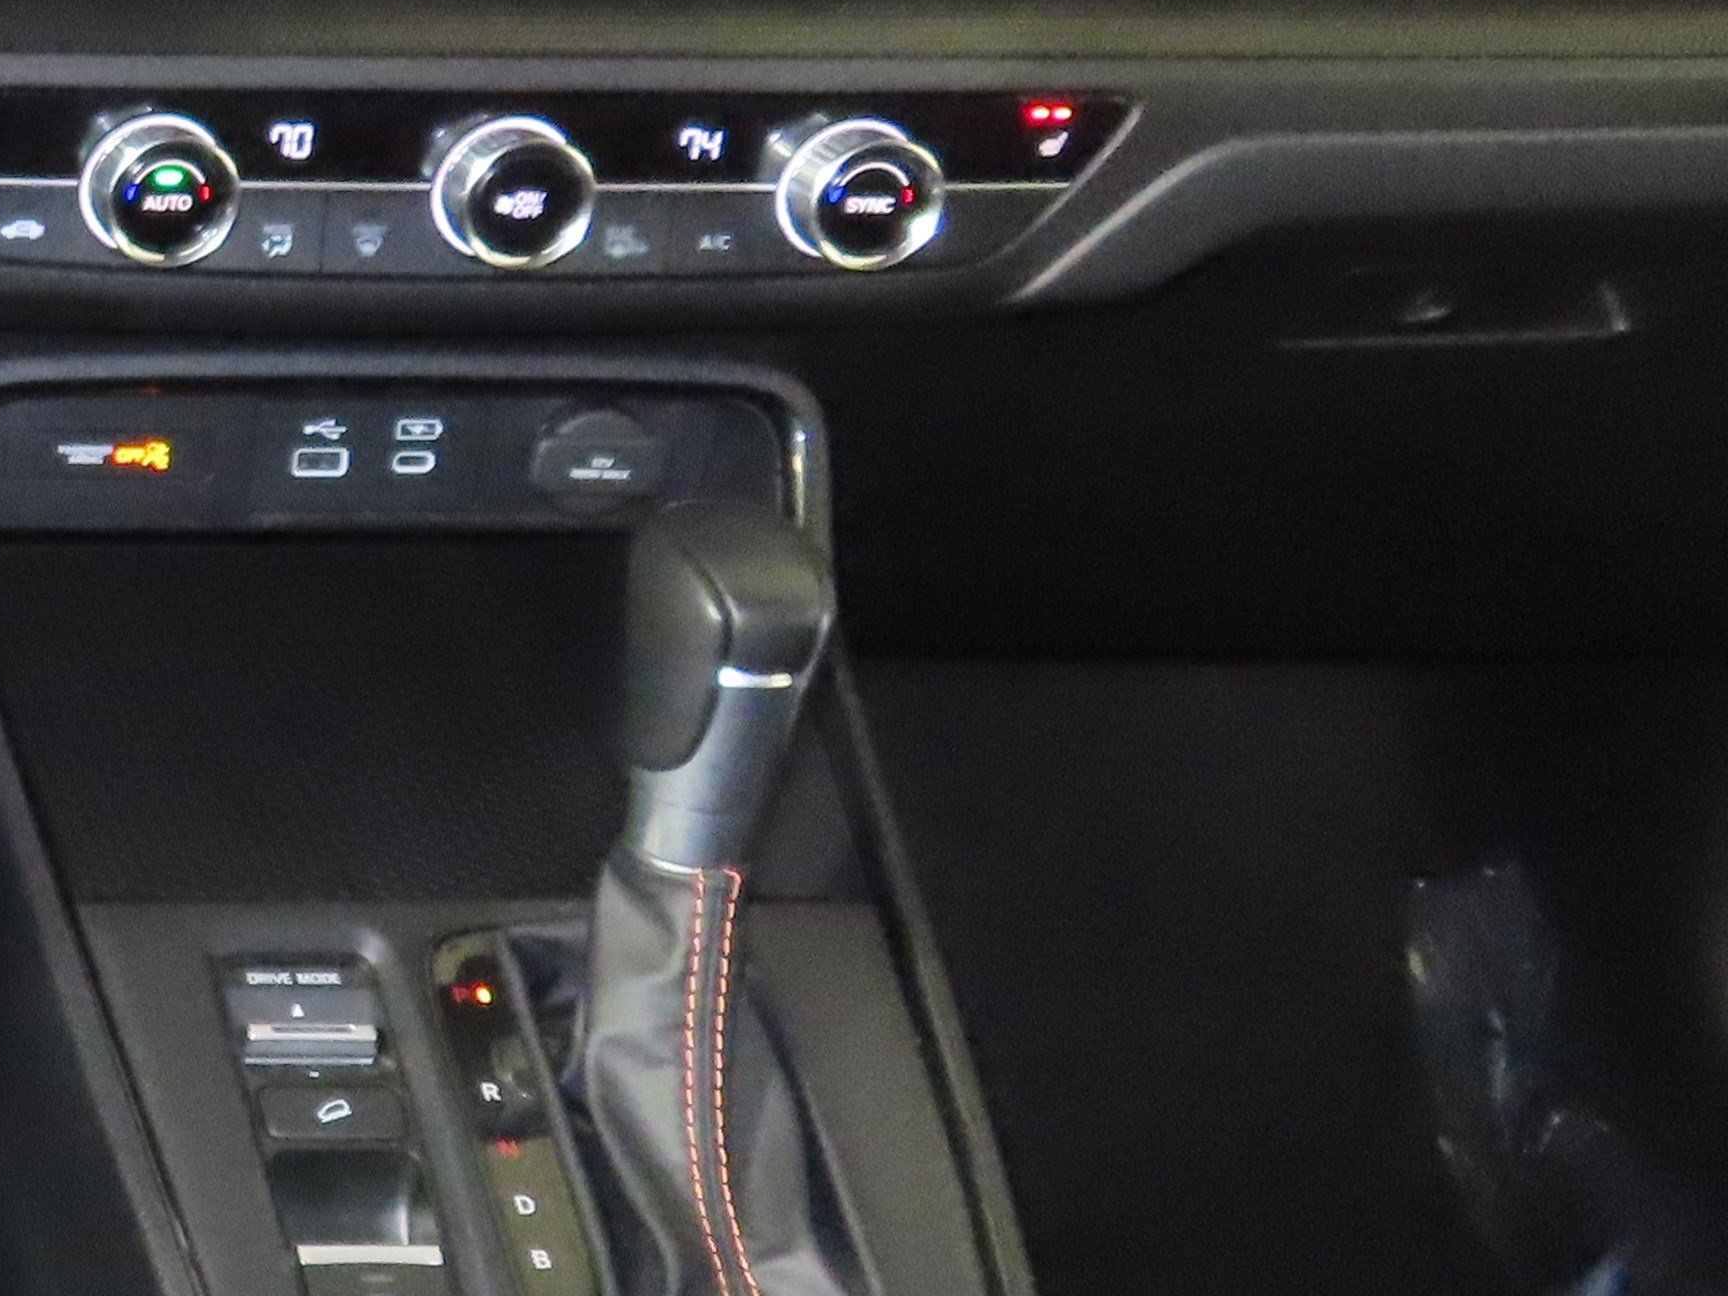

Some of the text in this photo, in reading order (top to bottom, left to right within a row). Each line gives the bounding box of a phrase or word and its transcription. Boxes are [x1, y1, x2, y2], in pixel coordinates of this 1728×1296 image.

[268, 120, 317, 161] 70
[678, 126, 726, 161] 74
[142, 194, 194, 213] AUTO
[844, 195, 896, 215] SYNC
[480, 1081, 502, 1103] R
[515, 1194, 537, 1216] D
[530, 1248, 552, 1271] B
